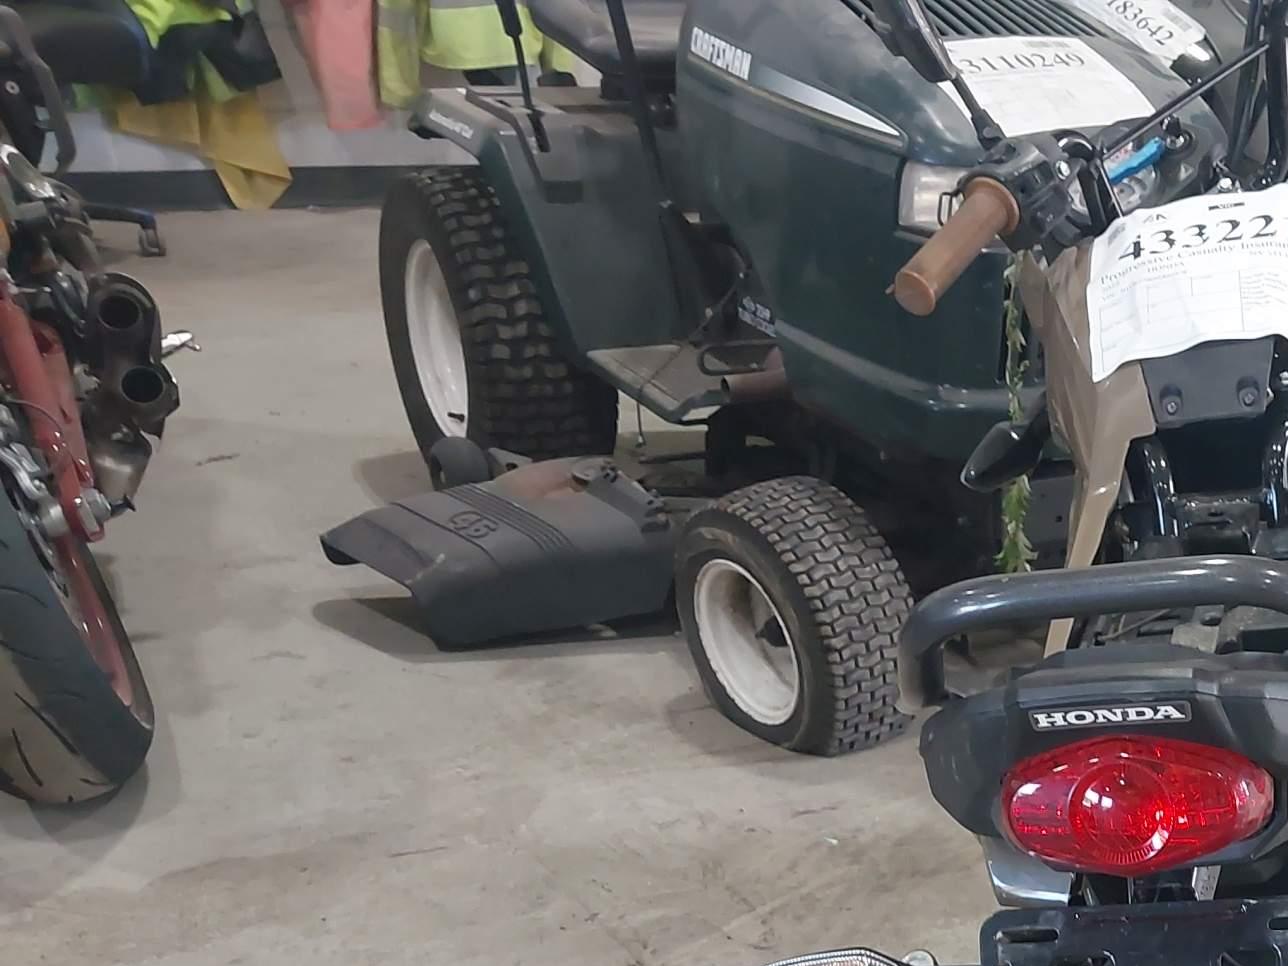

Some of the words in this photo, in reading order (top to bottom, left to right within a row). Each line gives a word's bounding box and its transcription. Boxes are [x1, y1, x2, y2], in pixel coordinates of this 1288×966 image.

[691, 26, 752, 80] CRAFTSMAN
[959, 53, 1085, 74] 3110249
[1033, 705, 1186, 728] HONDA
